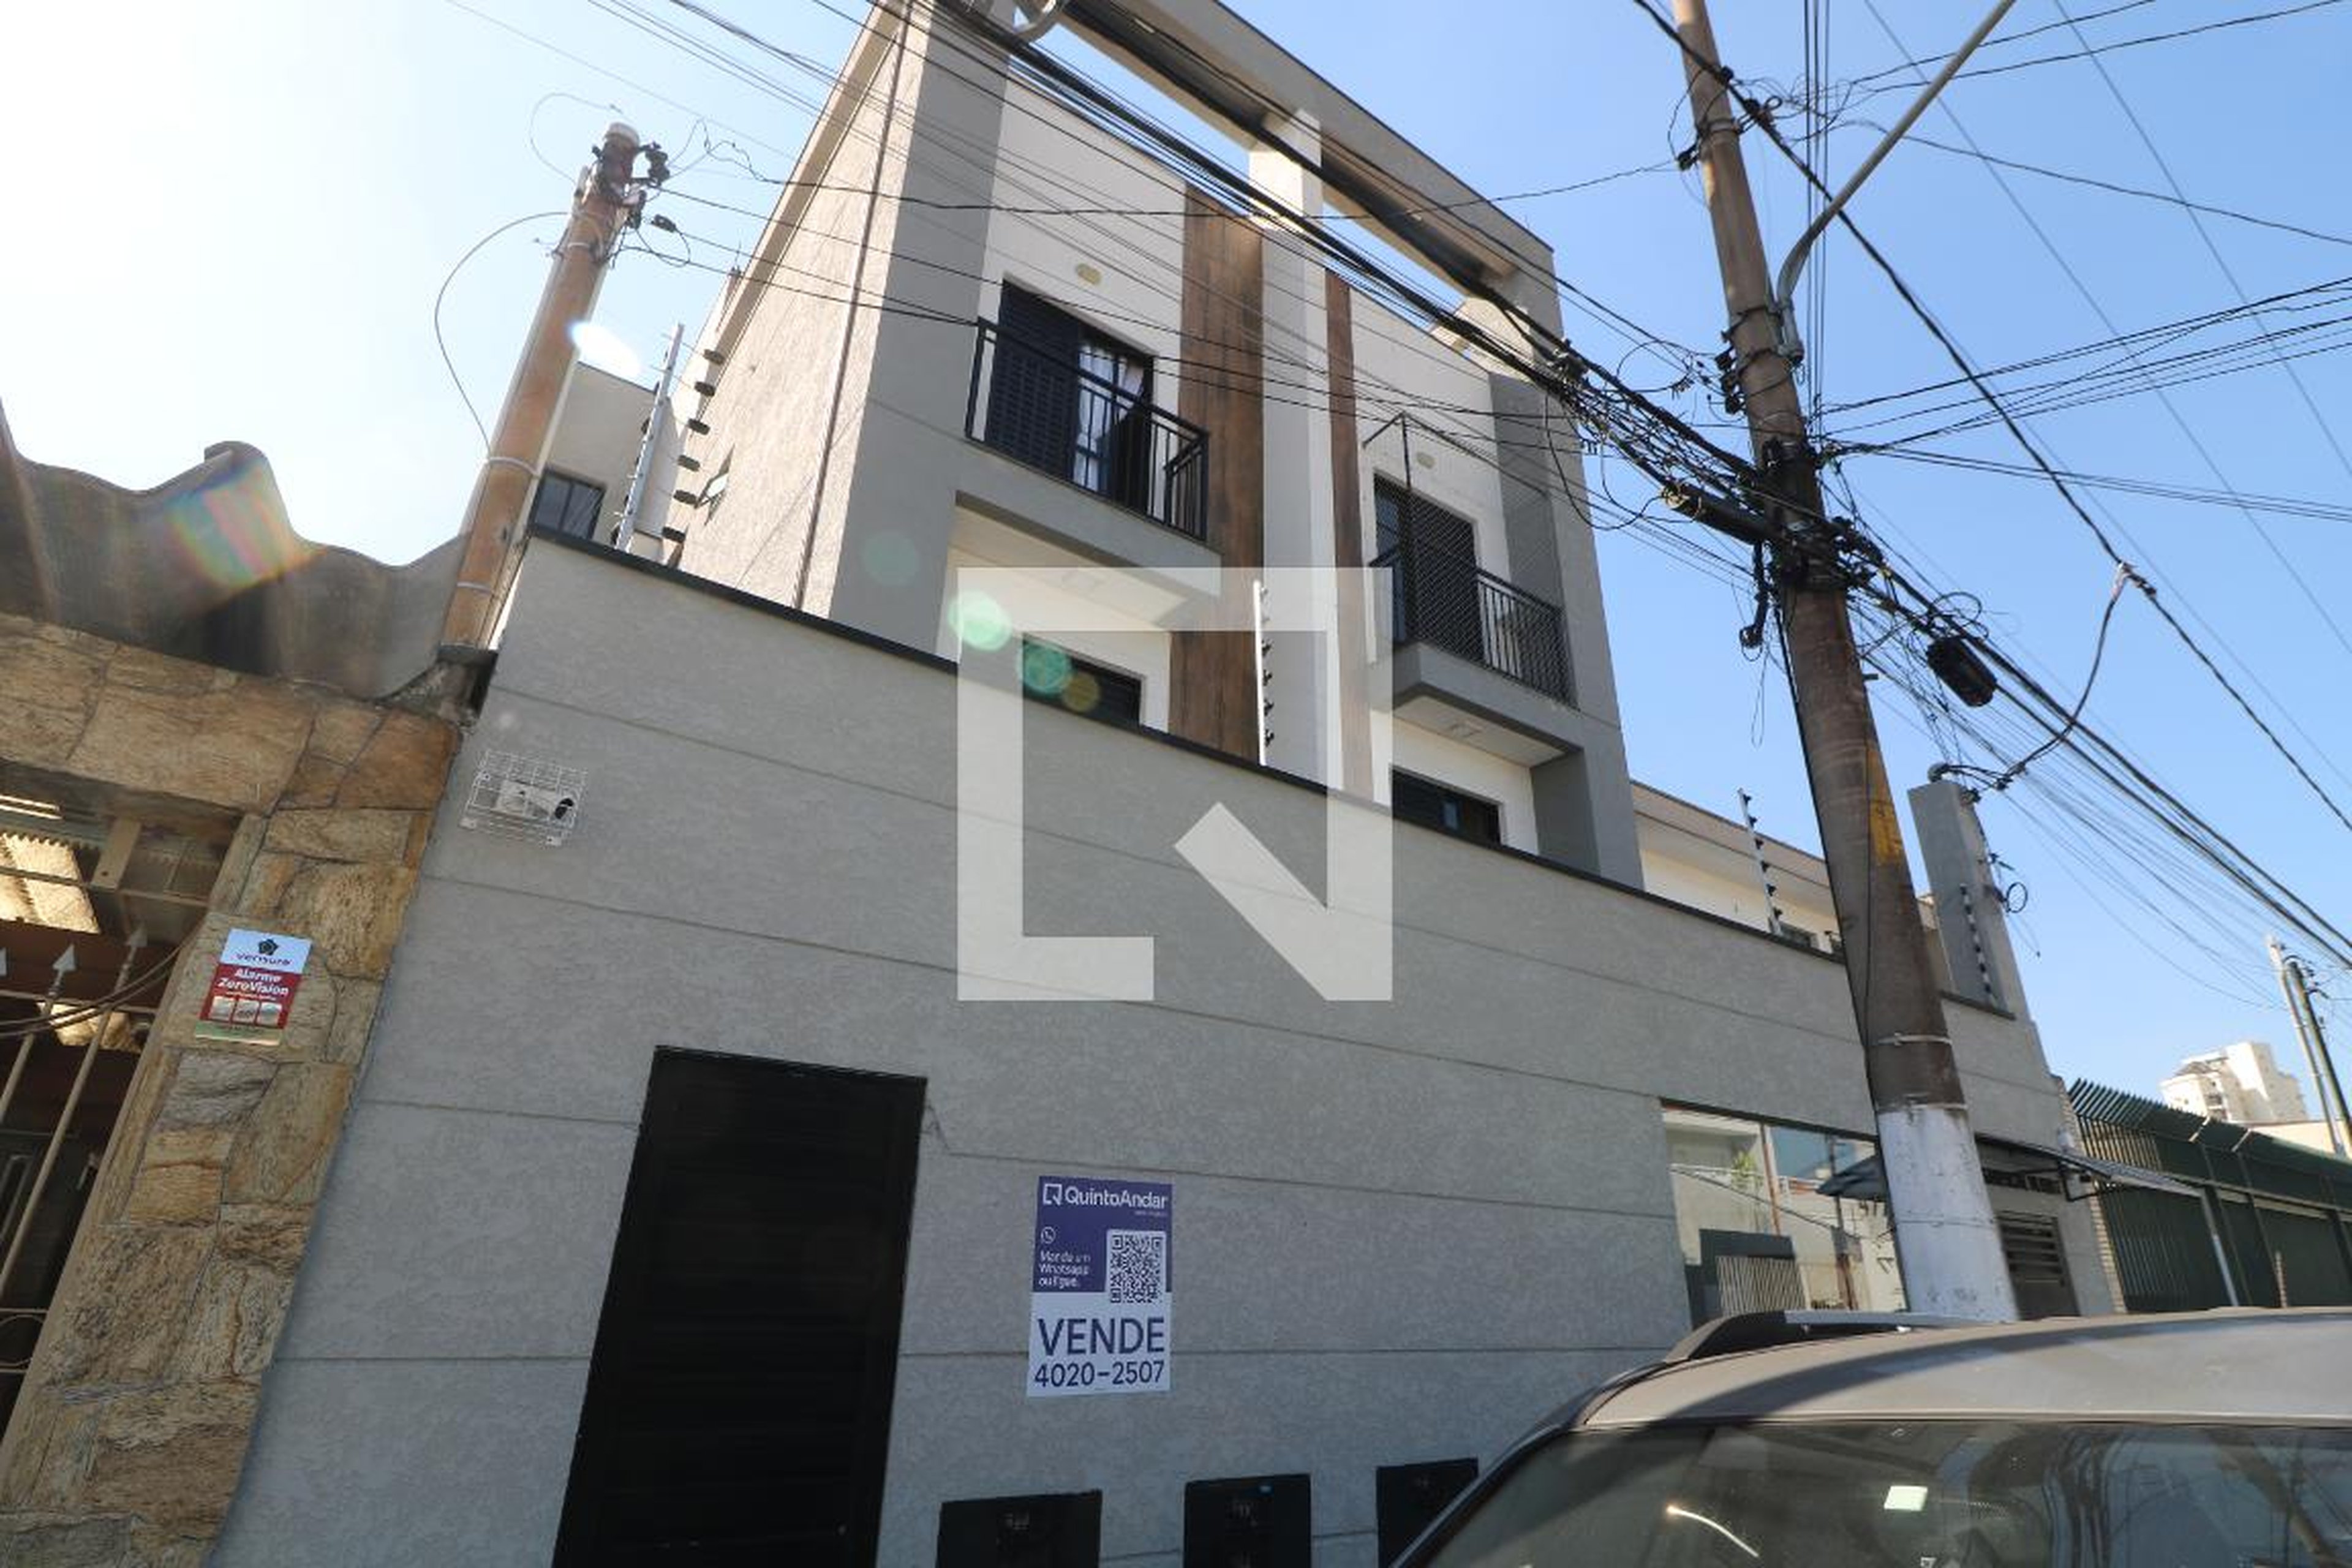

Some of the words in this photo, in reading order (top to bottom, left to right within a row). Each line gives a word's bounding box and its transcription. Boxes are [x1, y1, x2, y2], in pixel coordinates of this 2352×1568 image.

[235, 968, 282, 982] Alarme
[218, 978, 289, 996] ZeroVision
[1065, 1186, 1167, 1208] QuintoAndar
[1037, 1316, 1165, 1355] VENDE
[1034, 1360, 1165, 1387] 4020-2507
